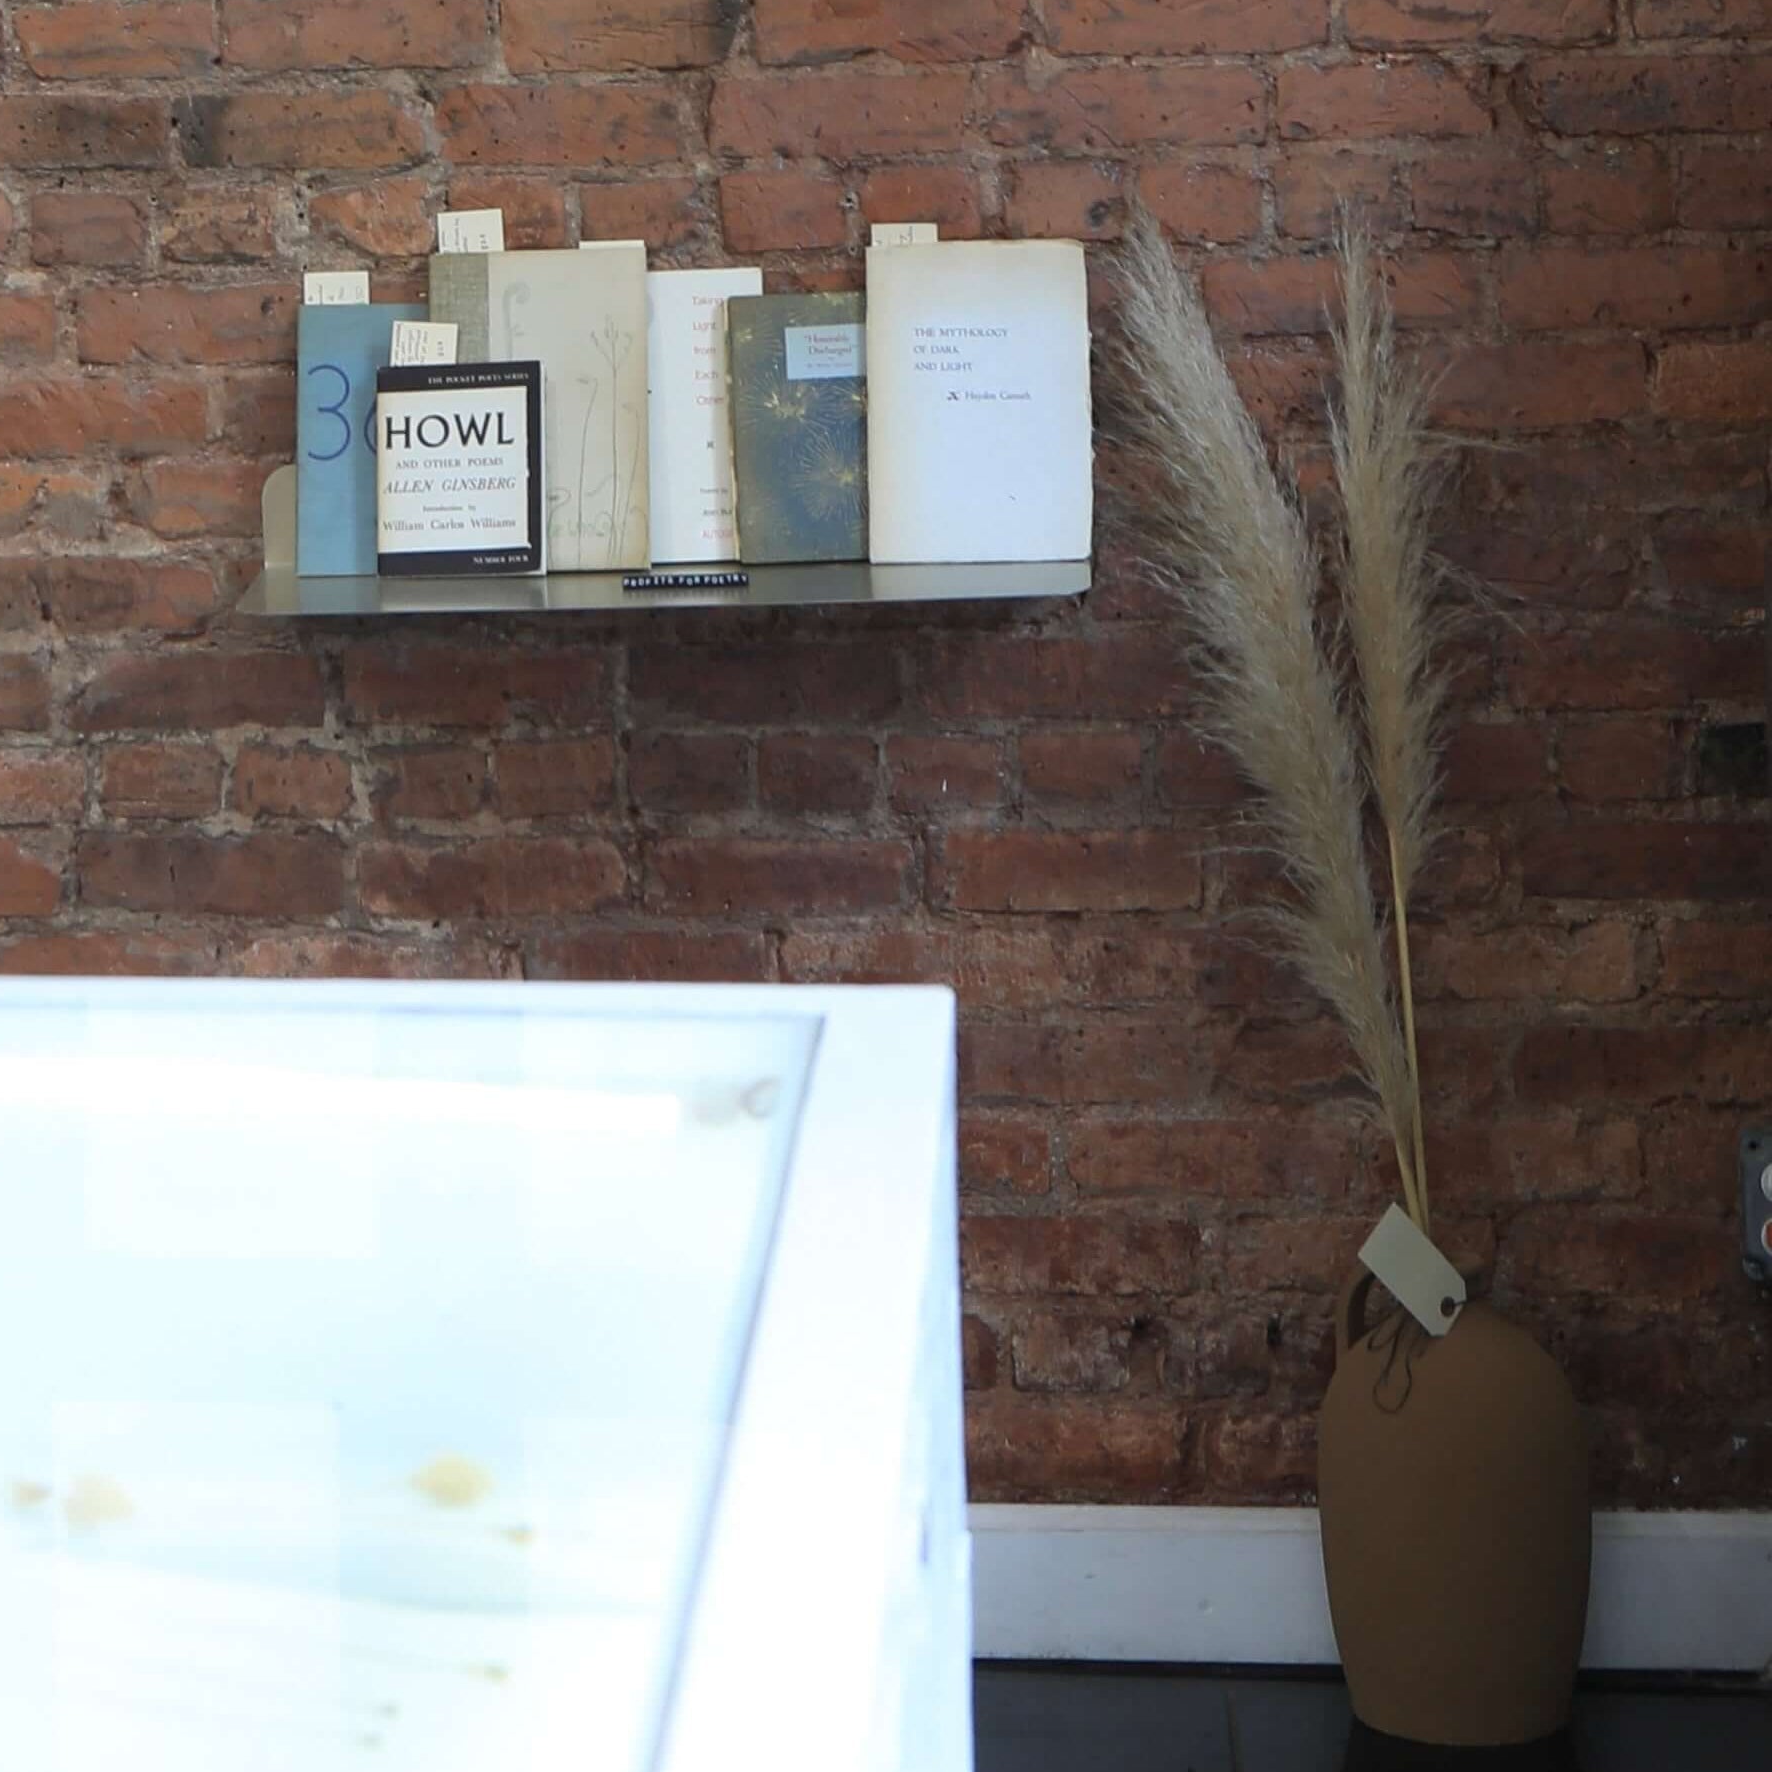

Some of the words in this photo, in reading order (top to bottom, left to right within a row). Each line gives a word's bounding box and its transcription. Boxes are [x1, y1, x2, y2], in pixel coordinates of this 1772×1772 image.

[385, 411, 515, 450] HOWL
[395, 459, 419, 470] AND
[423, 458, 461, 469] OTHER
[467, 457, 504, 468] POEMS
[383, 479, 434, 495] ALLEN
[441, 476, 517, 492] GINSBERG
[383, 519, 425, 531] William
[430, 518, 465, 530] Carlos
[470, 517, 517, 529] Williams
